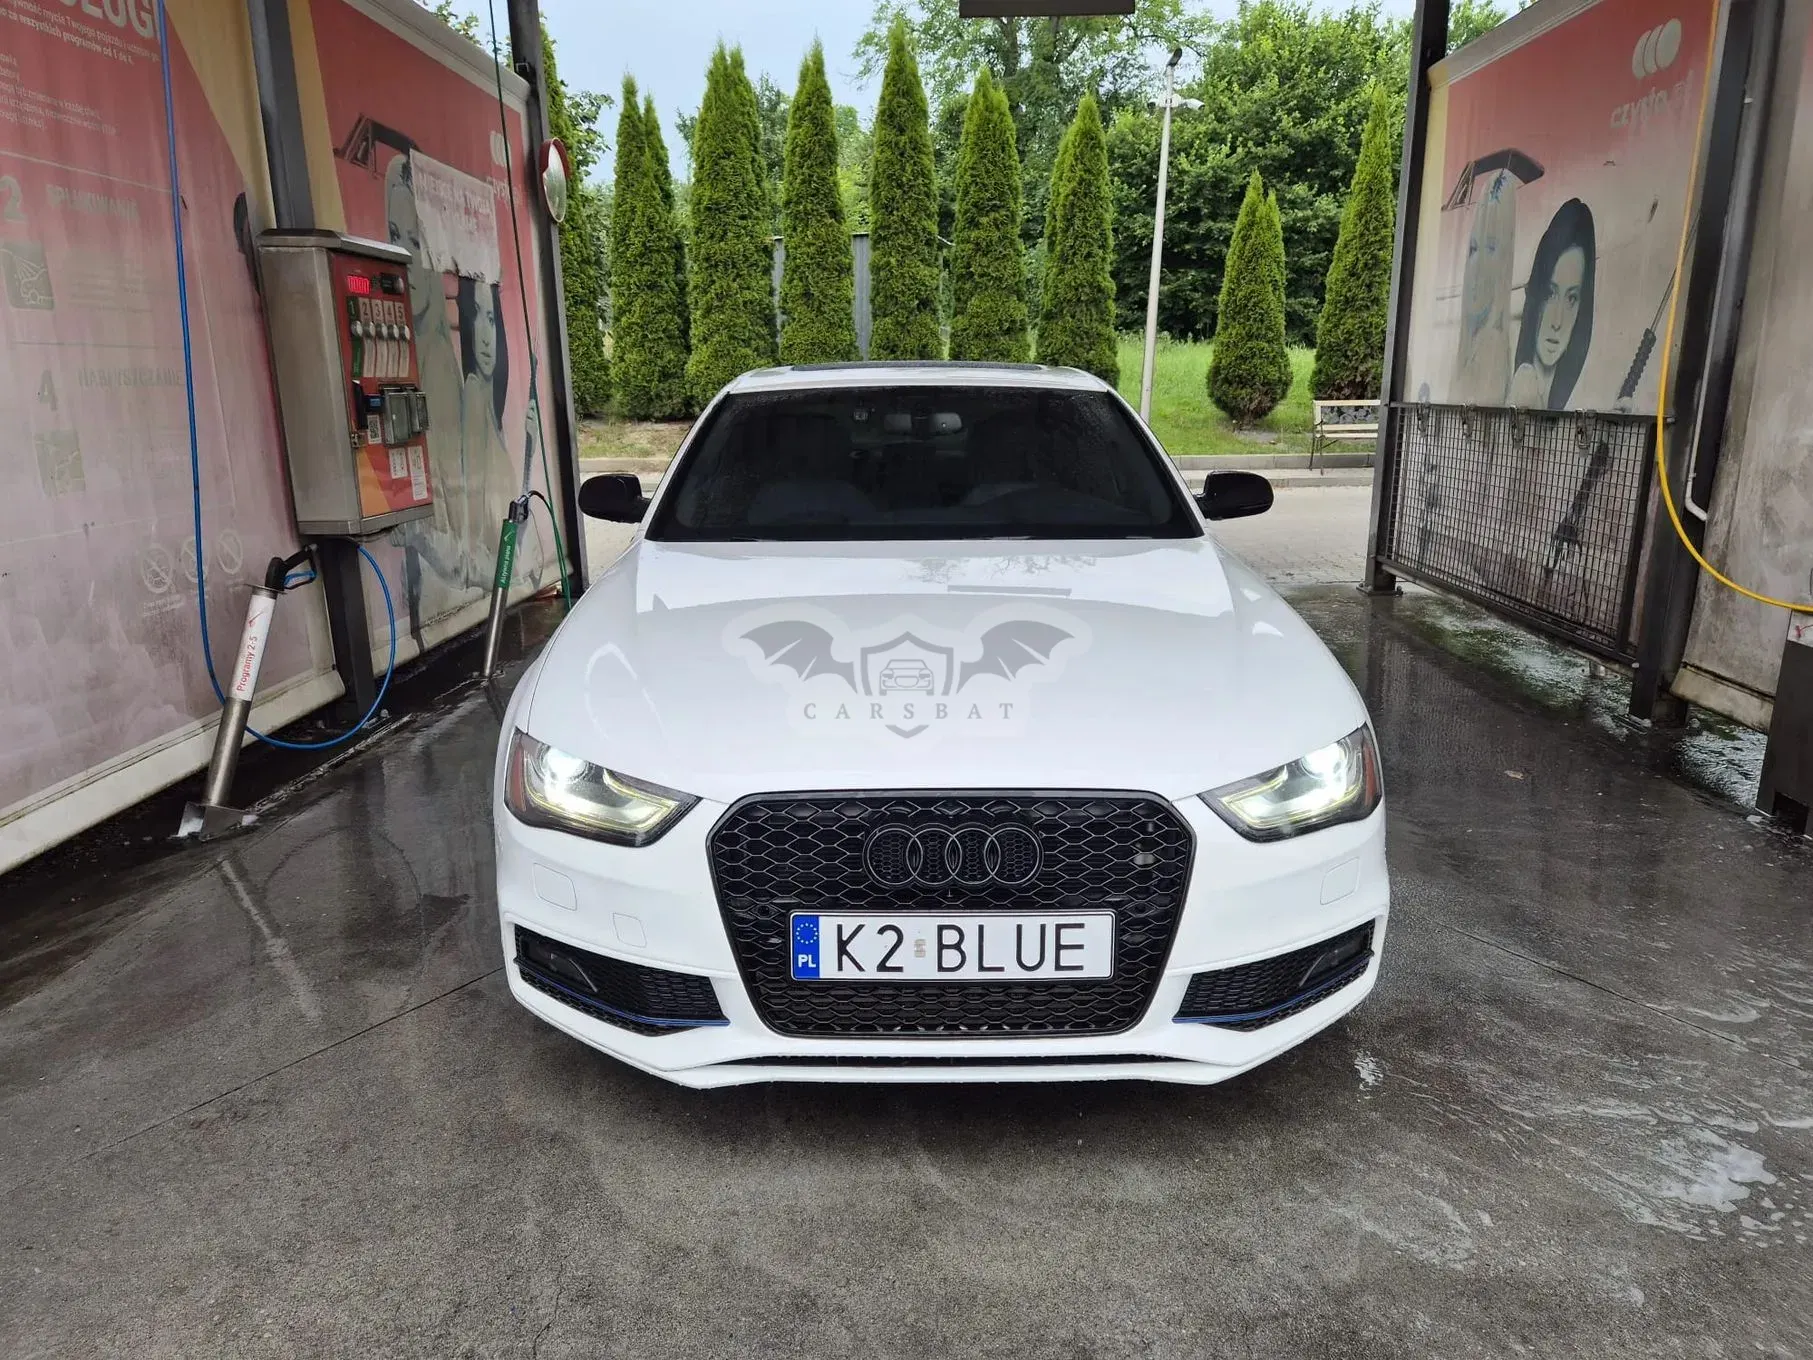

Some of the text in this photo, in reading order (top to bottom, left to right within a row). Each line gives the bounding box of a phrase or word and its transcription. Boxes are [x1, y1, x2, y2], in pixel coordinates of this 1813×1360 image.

[236, 650, 256, 692] Programy
[798, 953, 817, 968] PL
[836, 922, 1086, 973] K2 BLUE
